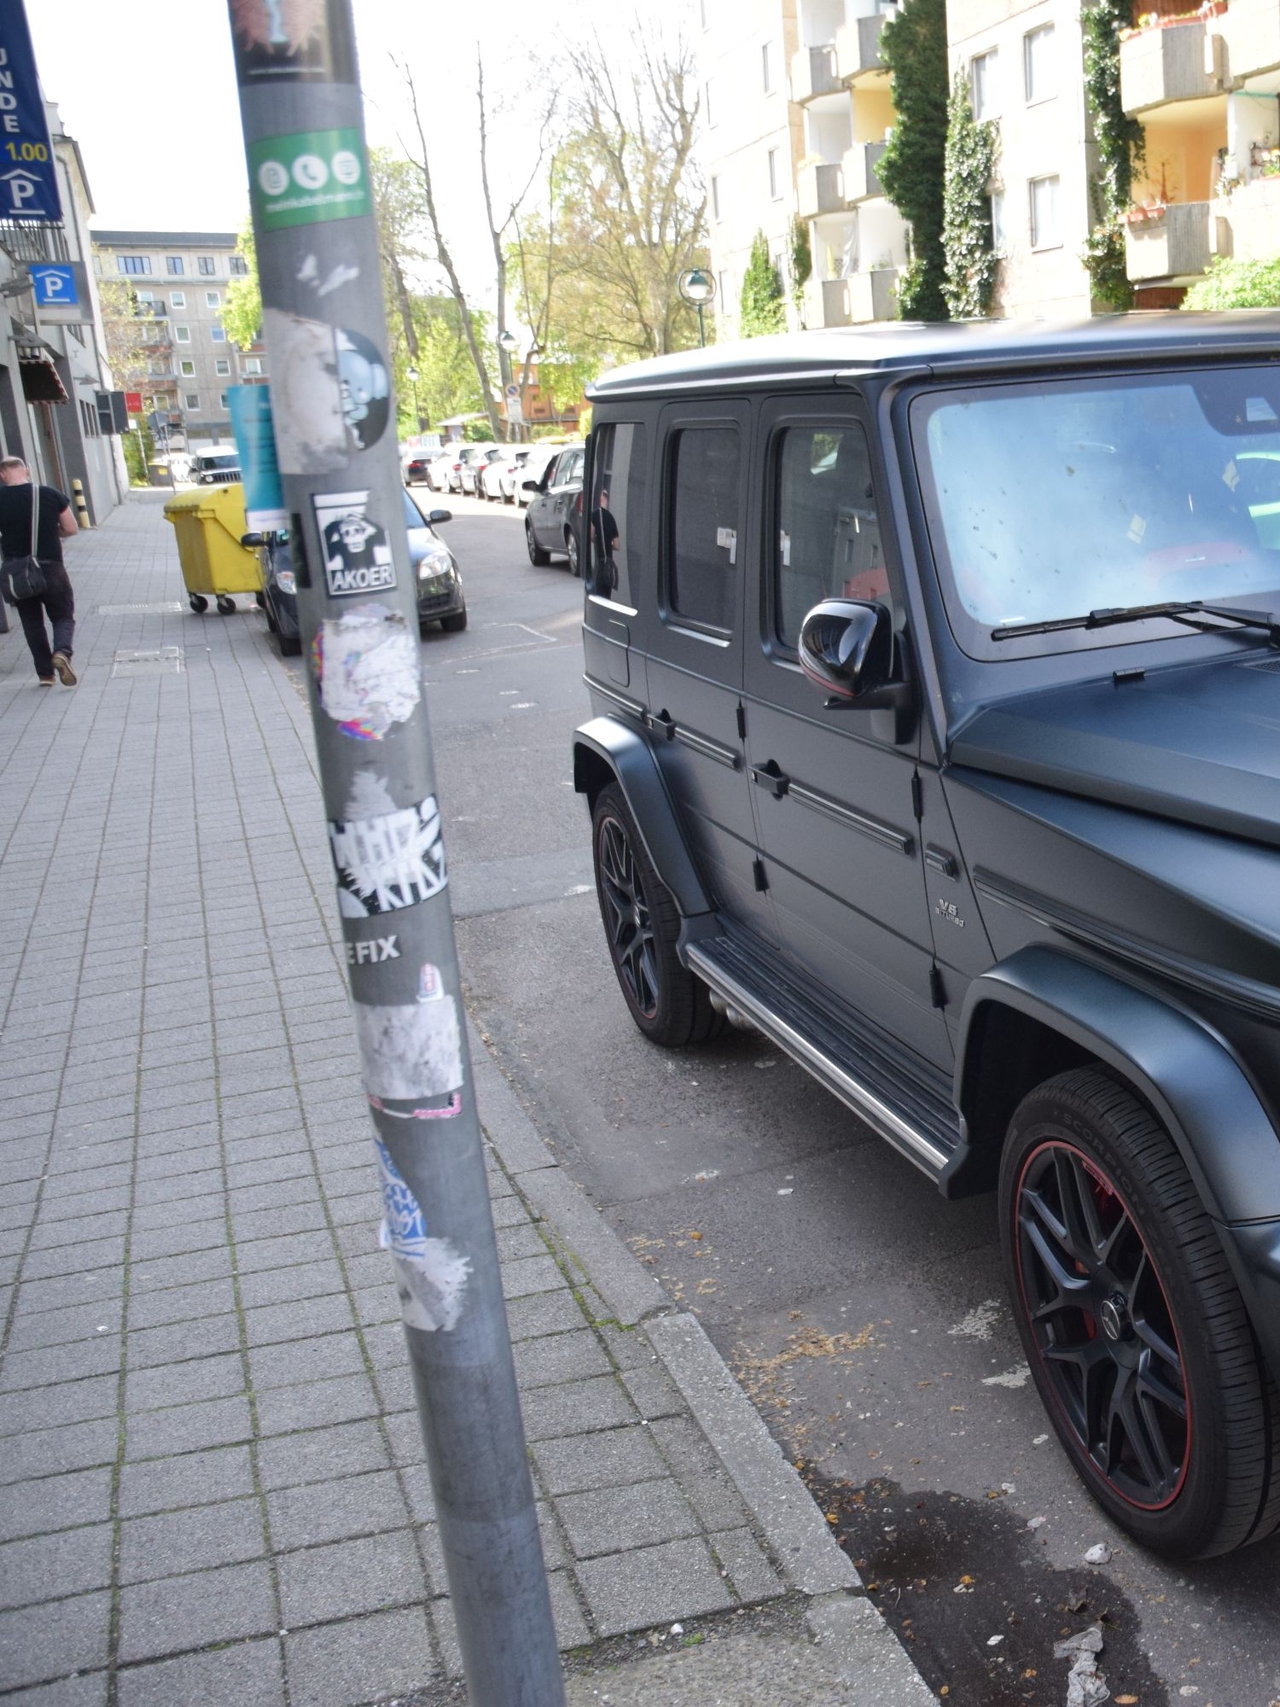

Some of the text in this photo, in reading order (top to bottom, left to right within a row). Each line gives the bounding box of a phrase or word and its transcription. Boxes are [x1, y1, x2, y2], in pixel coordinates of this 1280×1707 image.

[6, 142, 48, 162] 1.00
[44, 276, 64, 297] P
[332, 565, 392, 591] AKOER
[938, 898, 959, 916] V8
